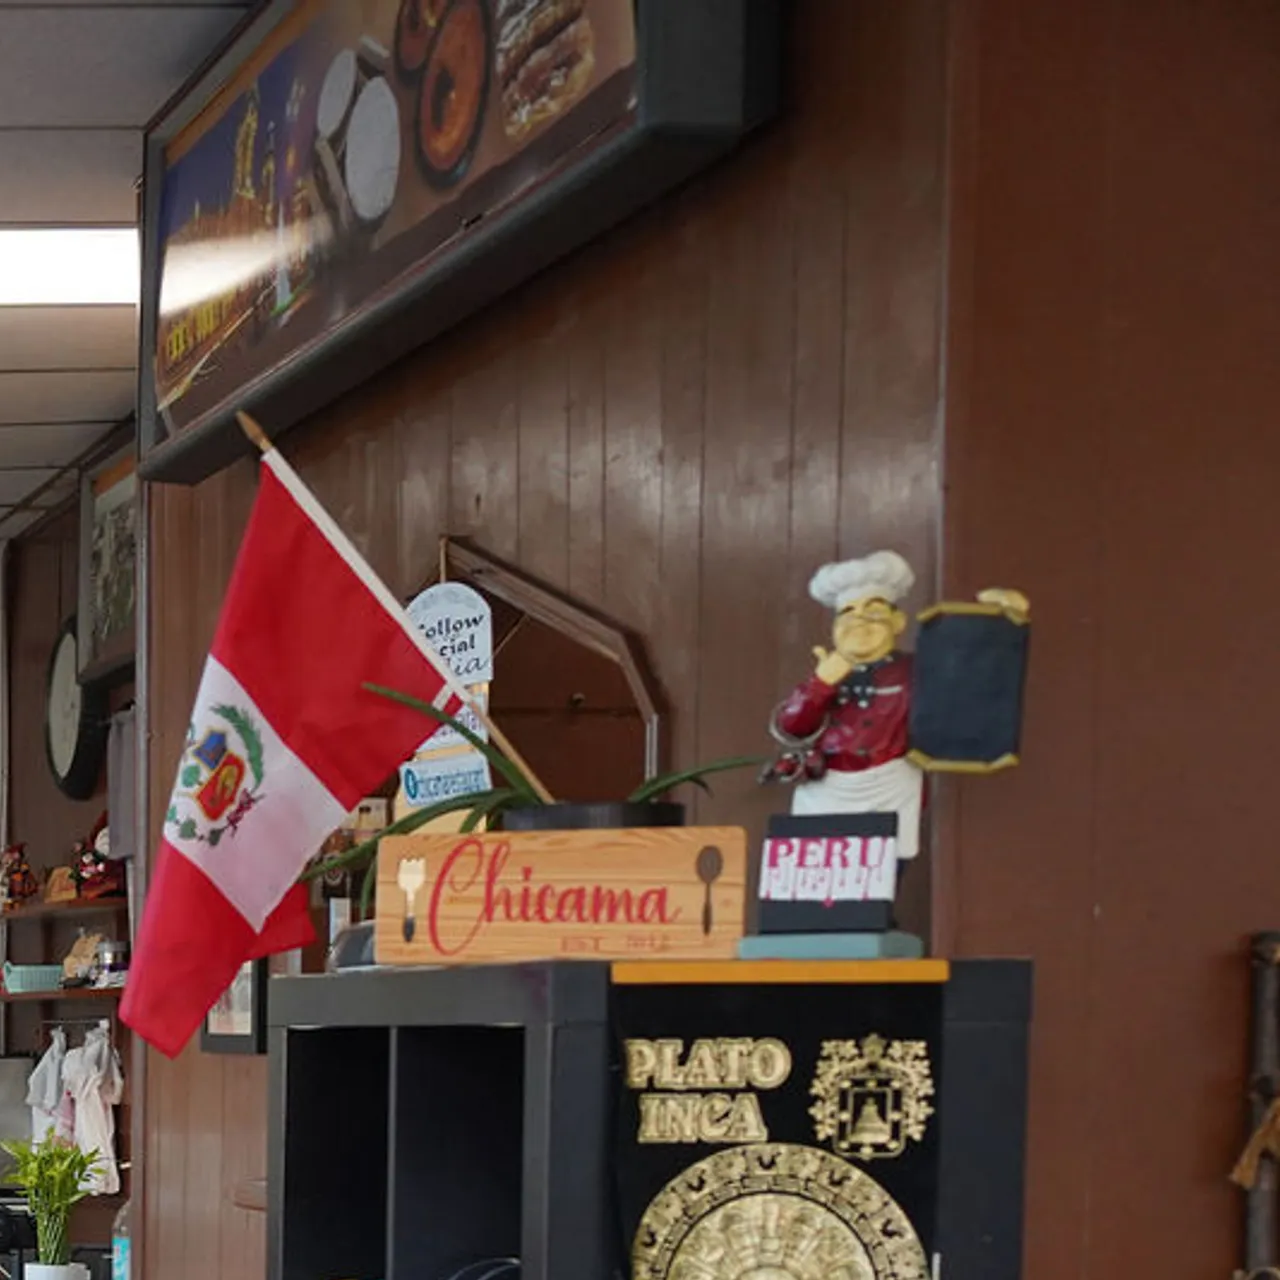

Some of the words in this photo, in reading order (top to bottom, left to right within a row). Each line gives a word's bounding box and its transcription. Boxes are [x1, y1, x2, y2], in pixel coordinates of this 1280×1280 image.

[419, 614, 484, 638] ollow
[439, 634, 475, 656] cial
[767, 836, 887, 868] PERU
[427, 838, 682, 956] Chicama
[625, 1037, 792, 1090] PLATO
[637, 1092, 769, 1143] INCA
